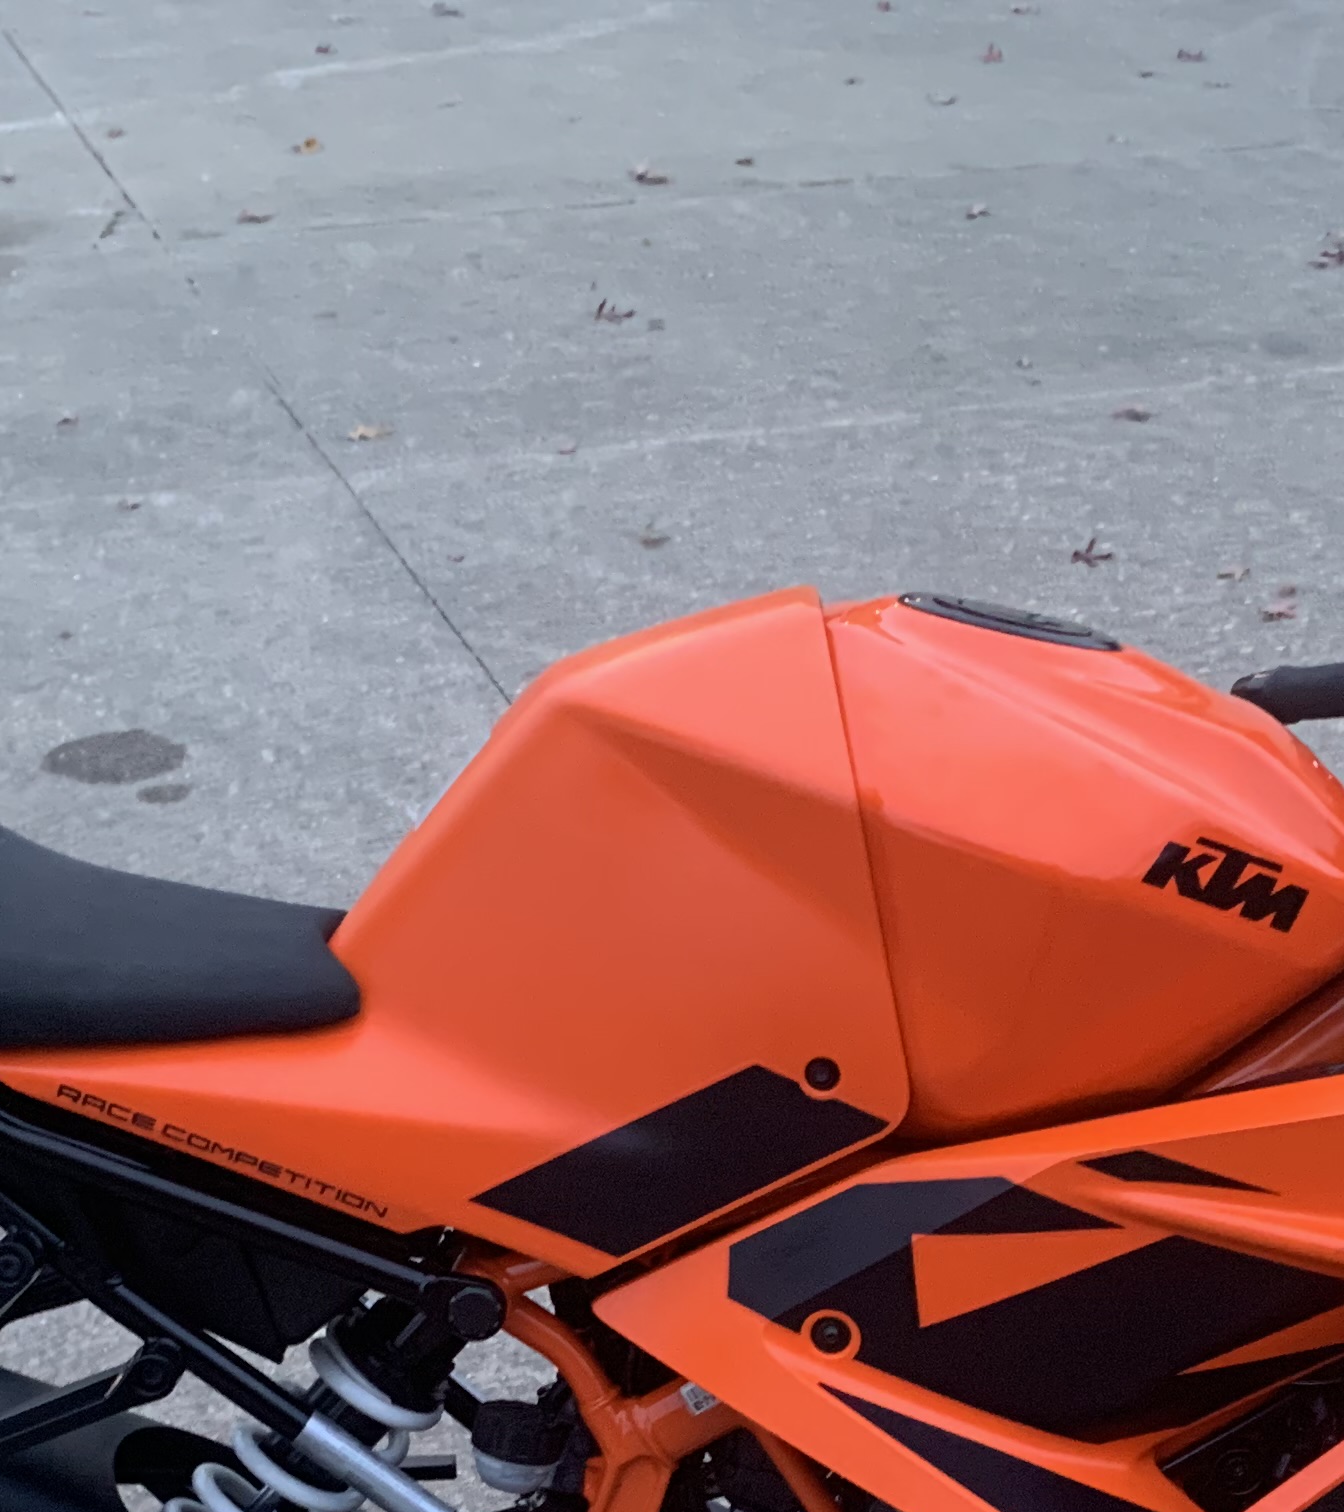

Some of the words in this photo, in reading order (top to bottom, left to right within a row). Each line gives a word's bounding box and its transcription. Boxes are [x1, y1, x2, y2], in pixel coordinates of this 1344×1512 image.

[1141, 836, 1309, 933] KTM
[57, 1083, 156, 1129] RACE
[161, 1123, 388, 1218] COMPETITION
